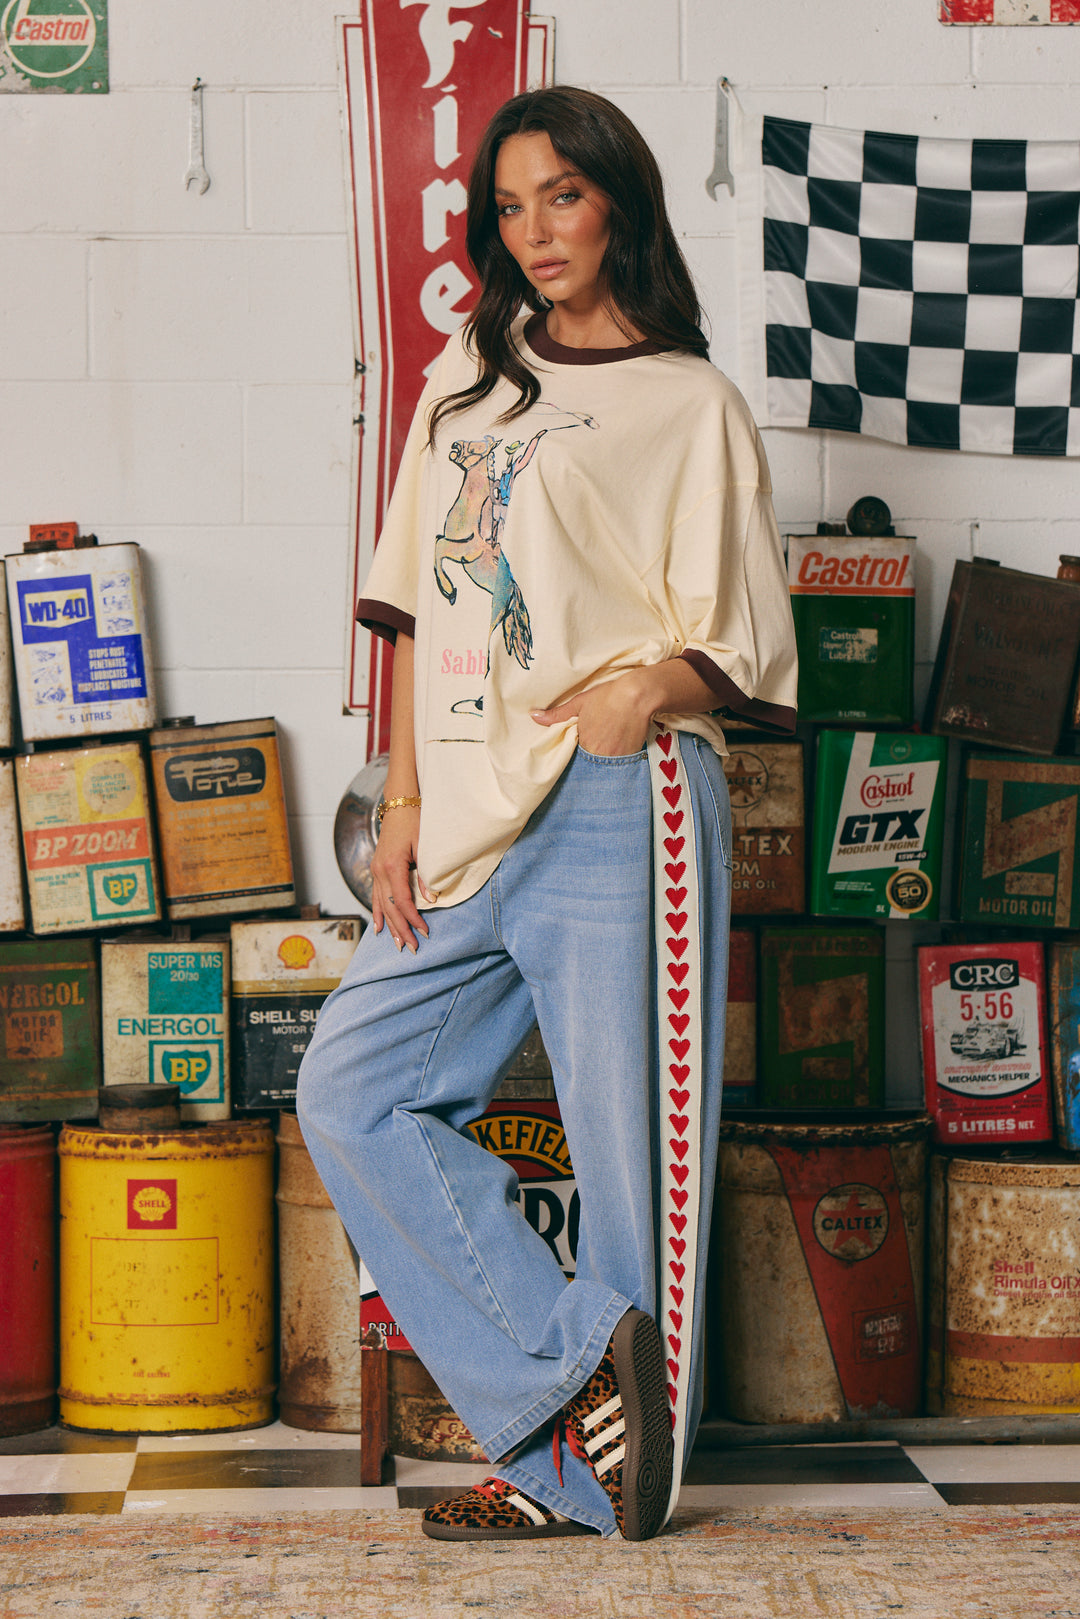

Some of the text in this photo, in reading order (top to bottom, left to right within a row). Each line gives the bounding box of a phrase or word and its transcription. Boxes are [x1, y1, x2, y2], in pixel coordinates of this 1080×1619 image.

[15, 18, 89, 41] Castrol
[400, 0, 488, 379] Fire
[798, 551, 910, 587] Castrol
[27, 597, 87, 623] WD-40
[88, 646, 125, 660] STOPS RUST
[89, 657, 127, 670] PENETRATES
[90, 668, 128, 681] LUBRICATES
[111, 677, 142, 690] MOISTURE
[69, 711, 112, 724] 5 LITRES
[860, 772, 915, 808] Castrol
[839, 809, 926, 845] GTX
[34, 827, 140, 860] BP ZOOM
[837, 840, 920, 856] MODERN ENGINE
[897, 851, 927, 861] 15W-40
[108, 878, 136, 899] BP
[755, 880, 776, 890] OIL
[979, 898, 1054, 917] MOTOR OIL
[149, 954, 222, 969] SUPER MS
[170, 970, 200, 982] 20/30
[953, 963, 1015, 988] CRC
[11, 1015, 56, 1029] MOTOR
[249, 1010, 297, 1025] SHELL
[117, 1018, 224, 1036] ENERGOL
[272, 1025, 307, 1036] MOTOR
[169, 1057, 208, 1082] BP
[948, 1072, 1030, 1084] MECHANICS HELPER
[948, 1121, 958, 1133] 5
[961, 1118, 1016, 1133] LITRES
[138, 1199, 167, 1208] SHELL
[821, 1215, 883, 1231] CALTEX
[994, 1260, 1034, 1274] Shell
[994, 1274, 1047, 1289] Rimula
[1050, 1276, 1071, 1290] Oil
[993, 1289, 1021, 1298] Diesel
[1022, 1291, 1053, 1300] engine
[1054, 1290, 1065, 1298] oil
[368, 1321, 405, 1337] RIT
